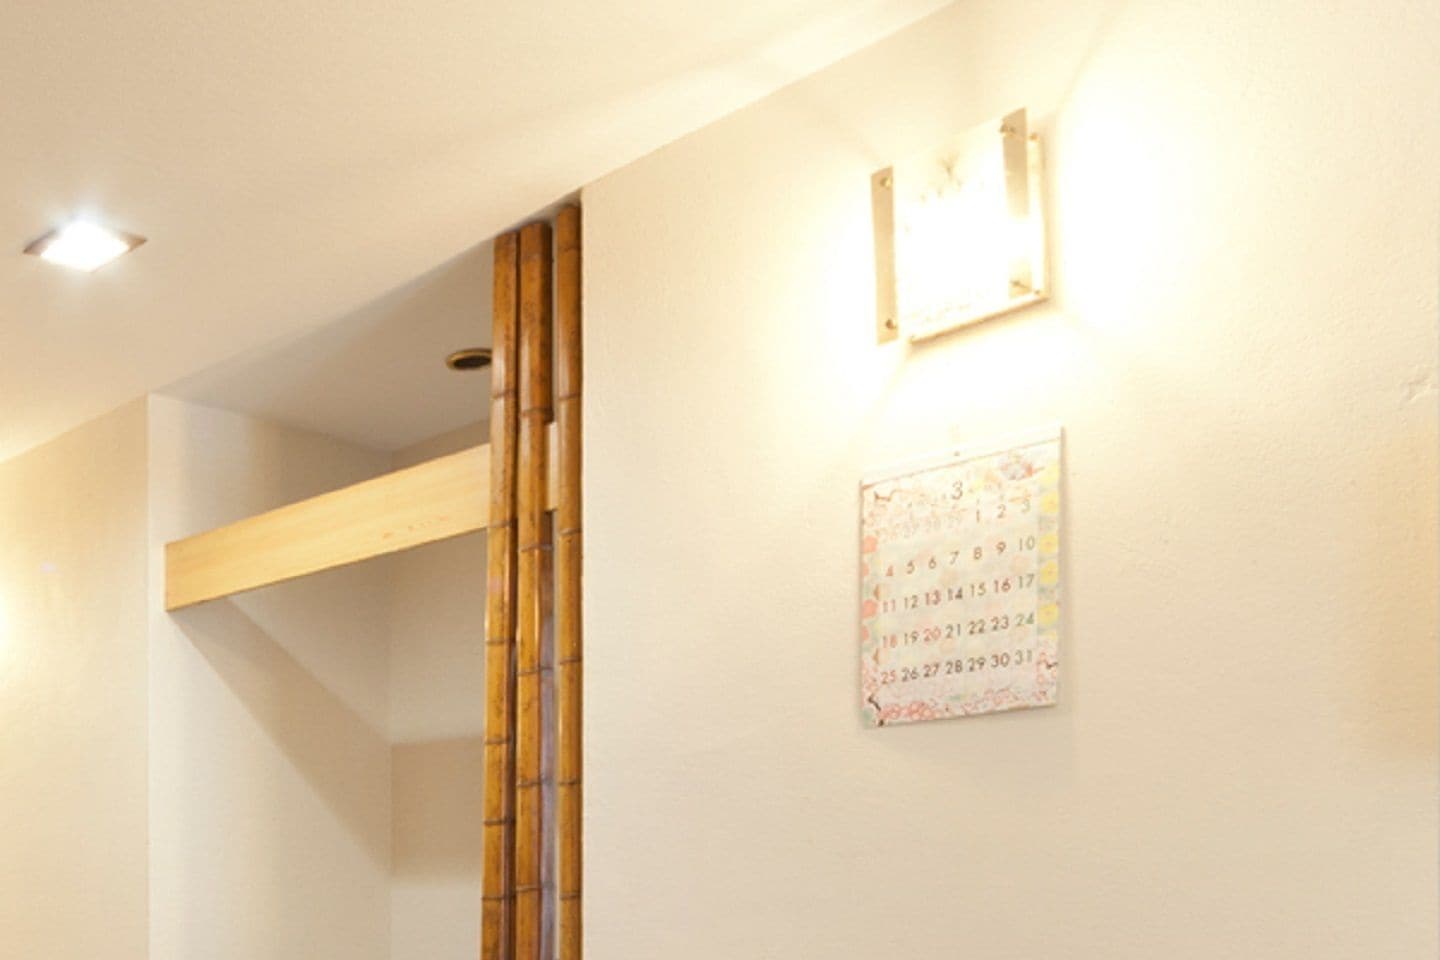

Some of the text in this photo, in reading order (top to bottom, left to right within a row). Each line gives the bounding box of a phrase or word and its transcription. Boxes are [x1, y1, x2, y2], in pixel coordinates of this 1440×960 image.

[950, 480, 964, 500] 3
[996, 504, 1007, 519] 2
[905, 560, 916, 575] 5
[927, 555, 937, 570] 6
[949, 550, 960, 566] 7
[972, 546, 983, 561] 8
[995, 541, 1006, 556] 9
[1018, 535, 1035, 551] 10
[882, 573, 1035, 614] 11 12 13 14 15 16 17
[882, 611, 1034, 649] 18 19 20 21 22 23 24
[880, 649, 1032, 685] 25 26 27 28 29 30 31
